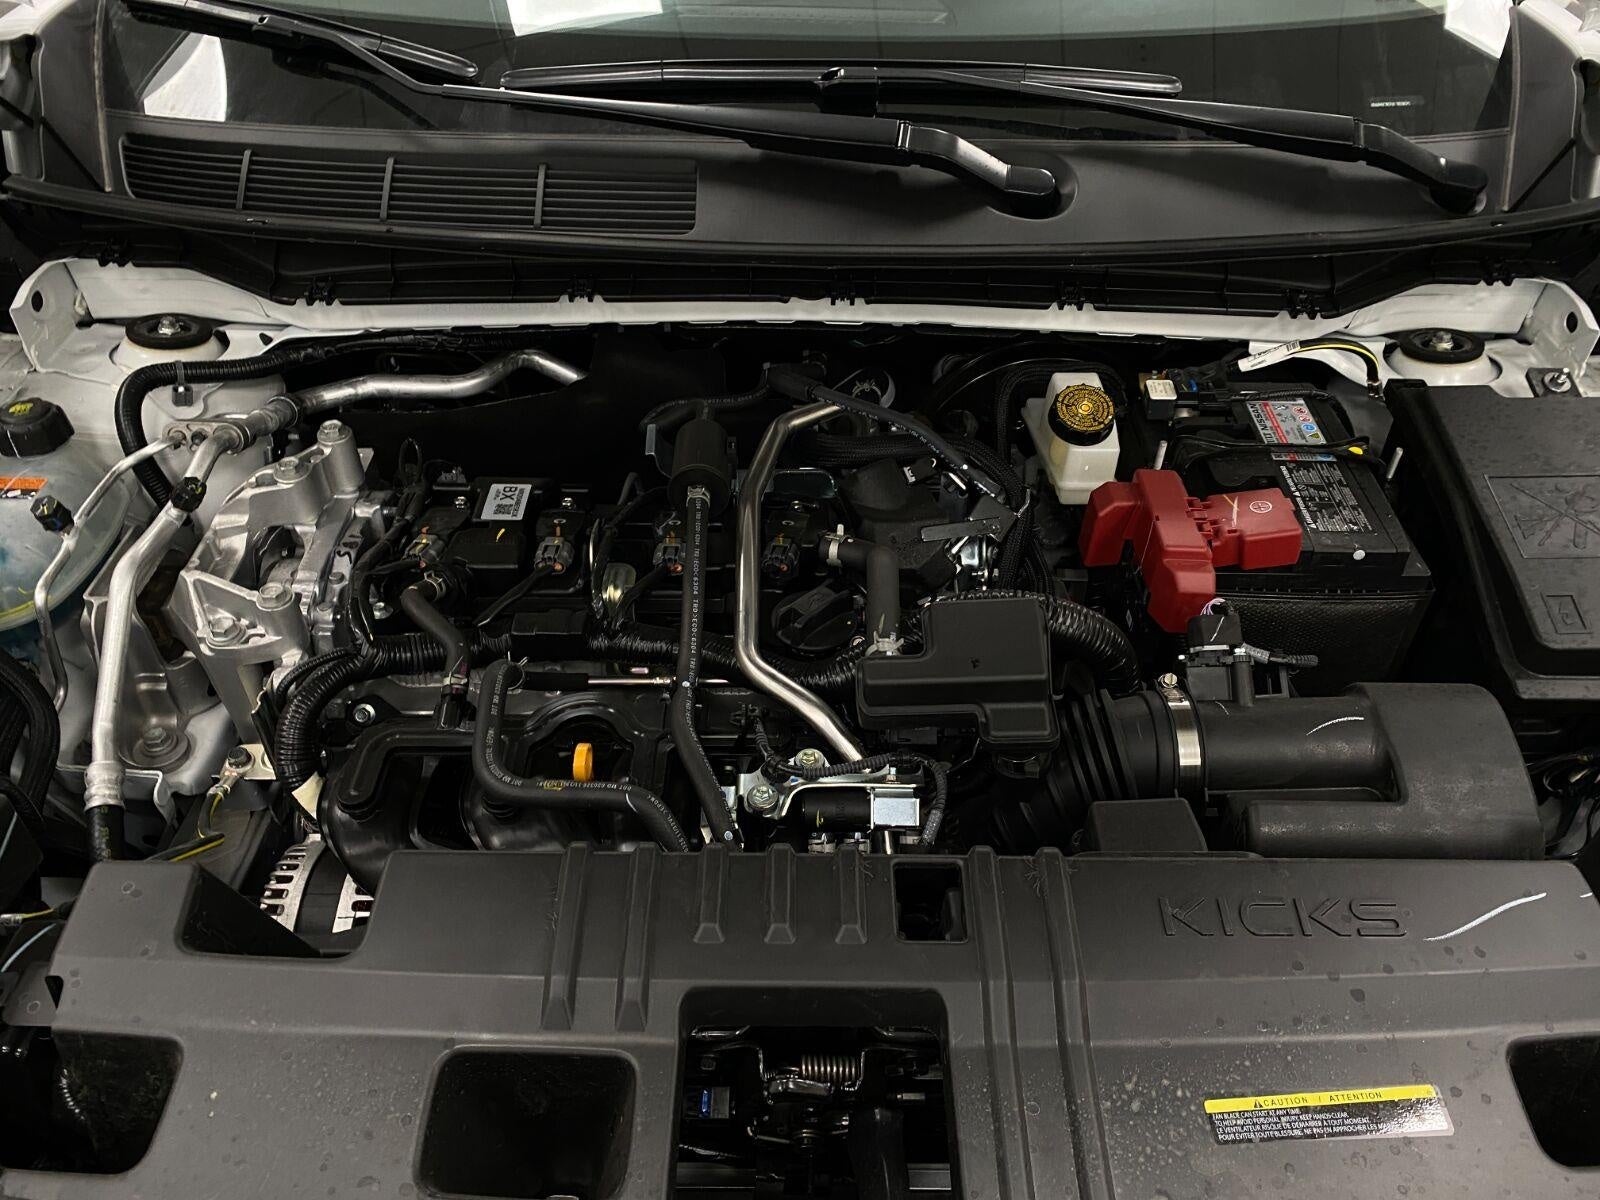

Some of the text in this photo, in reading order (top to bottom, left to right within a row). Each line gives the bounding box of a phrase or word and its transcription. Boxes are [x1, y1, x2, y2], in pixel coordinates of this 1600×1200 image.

[1249, 403, 1268, 430] NISSAN
[500, 486, 518, 500] BX
[1158, 897, 1407, 936] KICKS
[1263, 1092, 1382, 1107] CAUTION ATTENTION
[1252, 1110, 1269, 1118] START
[1253, 1116, 1280, 1124] PERSONAL
[1313, 1112, 1331, 1120] HANDS
[1223, 1124, 1261, 1133] VENTILATEUR
[1328, 1118, 1343, 1126] TOUT
[1254, 1130, 1274, 1138] TOUTE
[1313, 1126, 1323, 1134] PAS
[1332, 1124, 1367, 1132] APPROCHER
